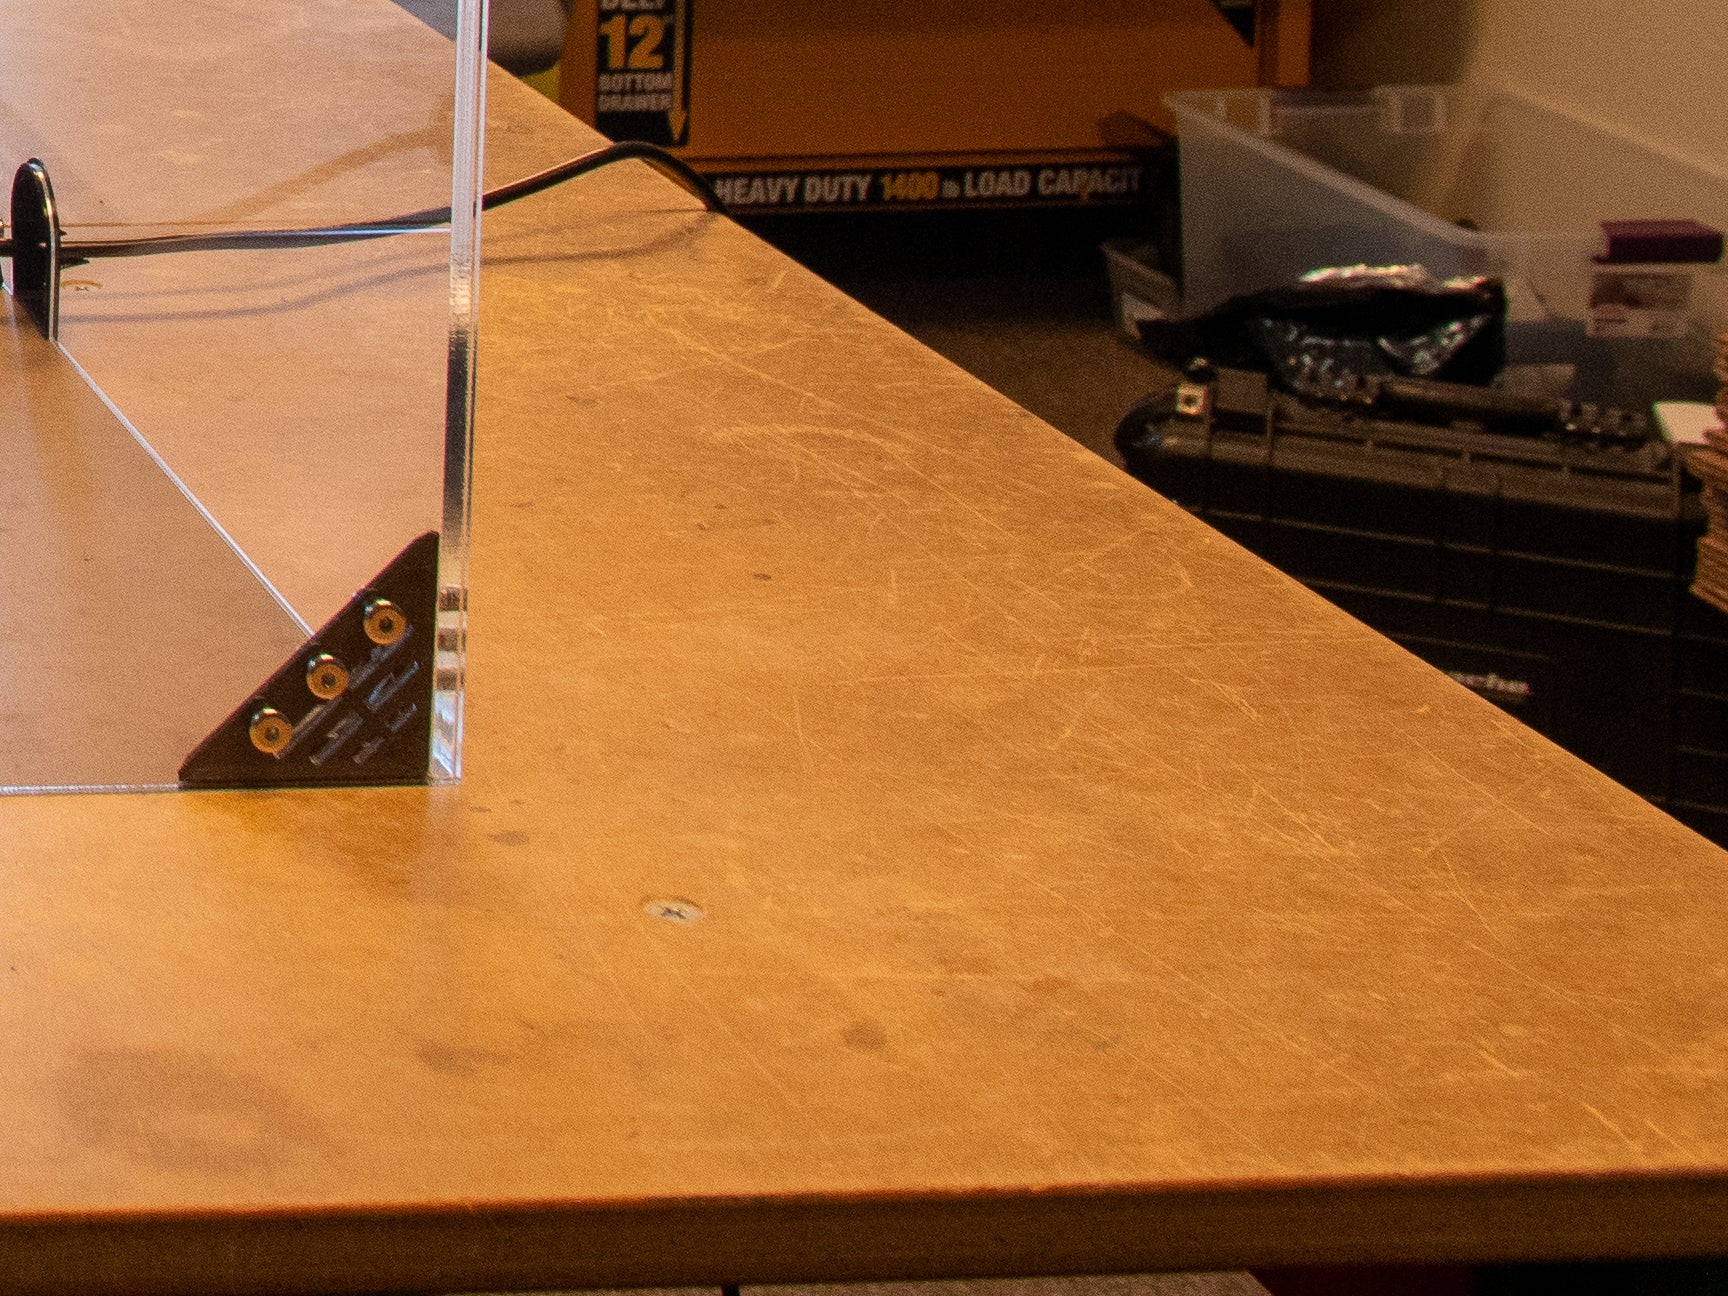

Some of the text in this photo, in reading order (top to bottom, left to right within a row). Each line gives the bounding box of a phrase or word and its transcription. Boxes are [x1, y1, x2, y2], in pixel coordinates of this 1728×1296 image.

[599, 71, 673, 91] BOTTOM
[598, 93, 672, 112] DRAWER
[714, 176, 800, 205] HEAVY
[804, 173, 872, 202] DUTY
[964, 169, 1032, 198] LOAD
[1038, 166, 1143, 196] CAPACIT
